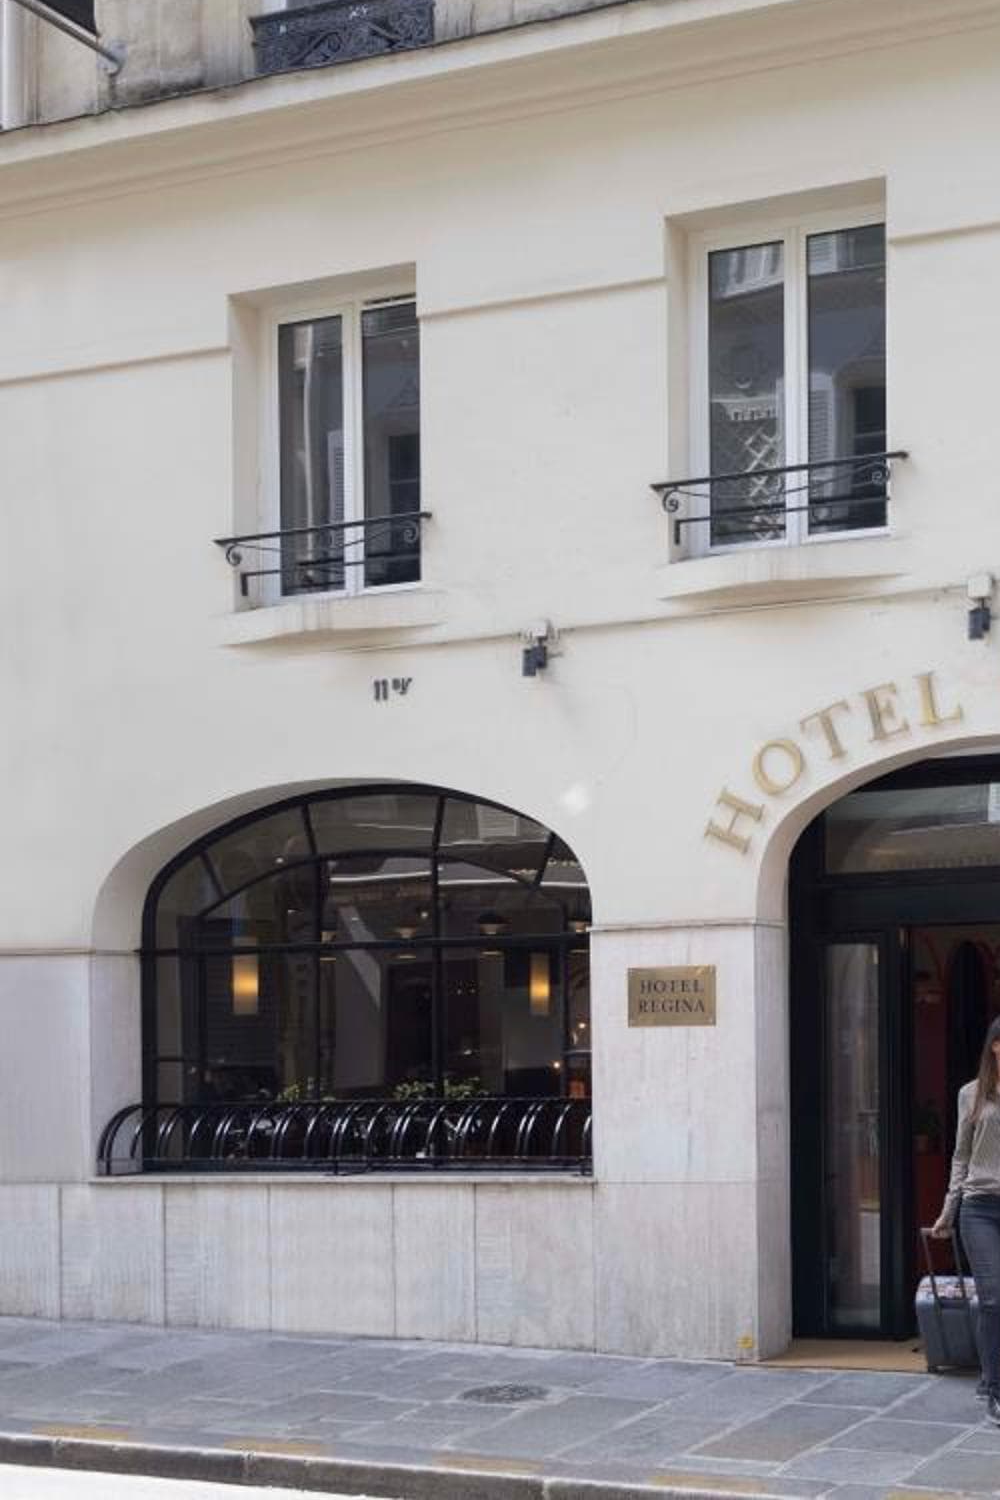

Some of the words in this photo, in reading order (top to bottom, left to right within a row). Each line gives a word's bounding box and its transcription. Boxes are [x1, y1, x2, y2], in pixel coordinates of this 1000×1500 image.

[373, 679, 388, 702] 11
[703, 670, 965, 855] HOTEL
[639, 979, 705, 994] HOTEL
[638, 999, 705, 1013] REGINA
